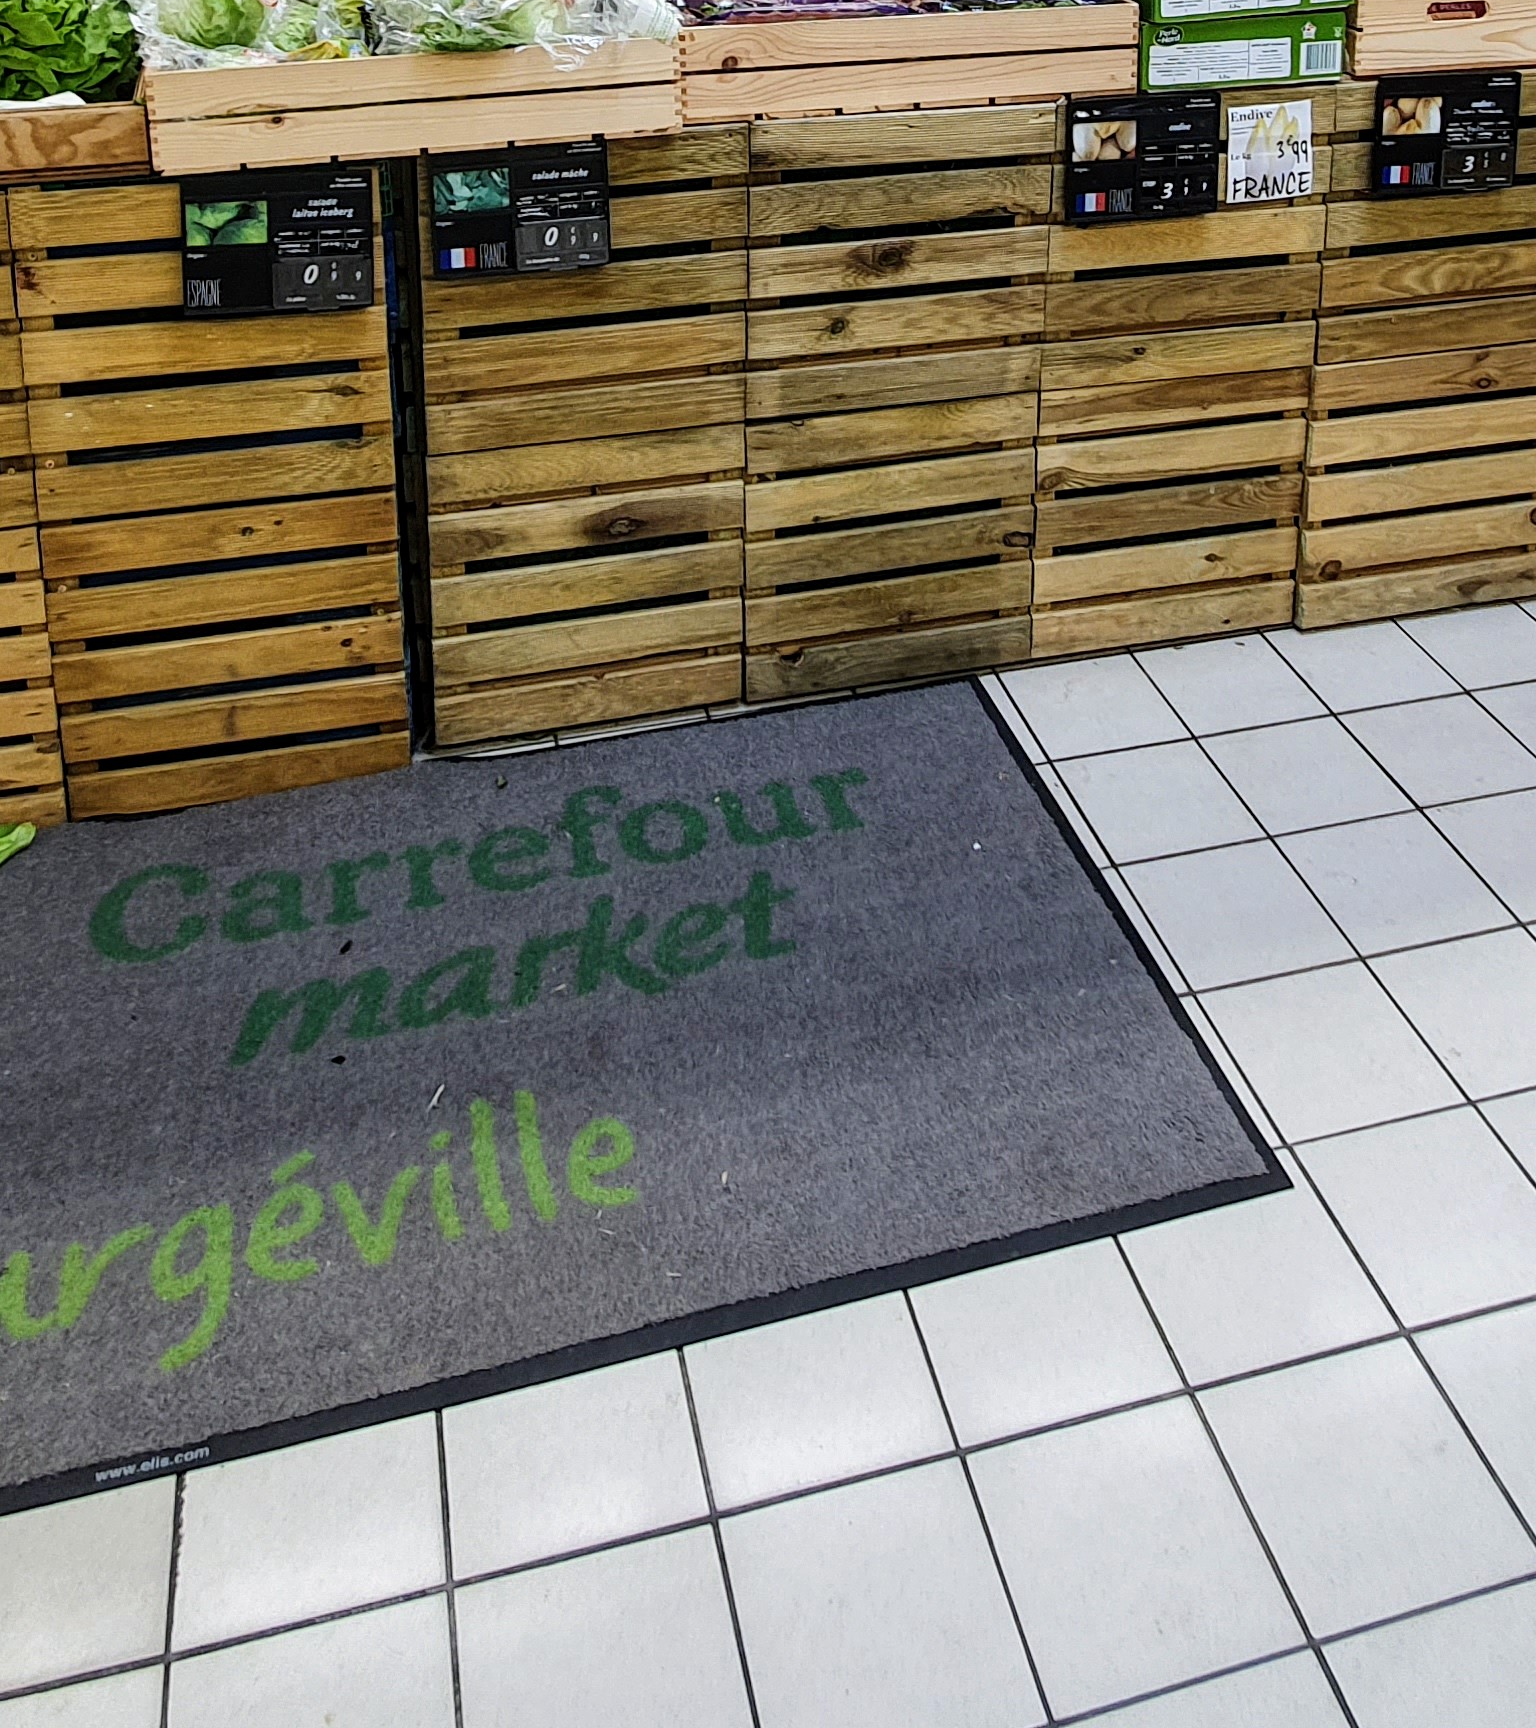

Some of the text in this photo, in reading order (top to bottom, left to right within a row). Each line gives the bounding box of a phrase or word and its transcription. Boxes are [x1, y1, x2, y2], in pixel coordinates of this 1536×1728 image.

[1230, 110, 1274, 123] Endive
[1462, 155, 1476, 173] 3
[1160, 182, 1173, 199] 3
[1232, 171, 1312, 200] FRANCE
[478, 241, 510, 269] FRANCE
[187, 278, 222, 308] ESPAGNE
[87, 767, 869, 963] Carrefour
[229, 870, 796, 1066] market
[94, 1446, 211, 1482] www.elis.com
